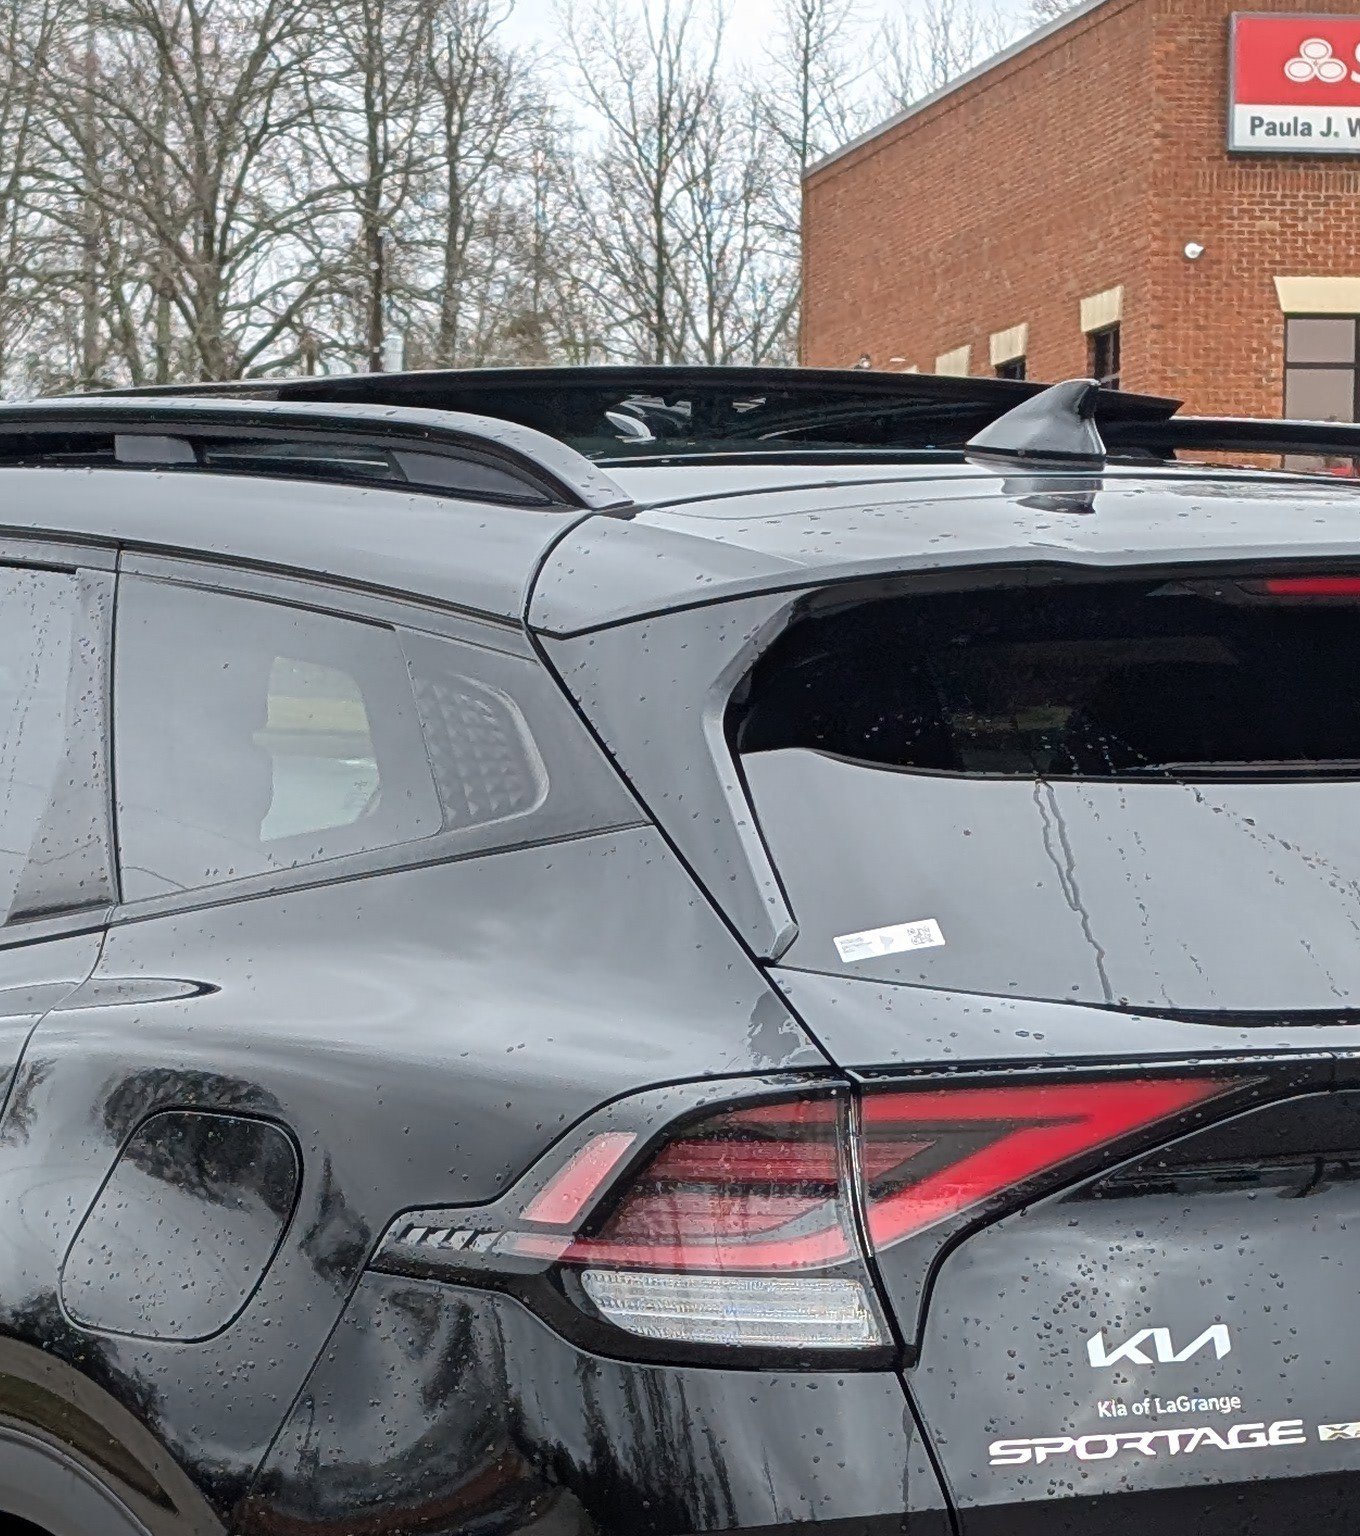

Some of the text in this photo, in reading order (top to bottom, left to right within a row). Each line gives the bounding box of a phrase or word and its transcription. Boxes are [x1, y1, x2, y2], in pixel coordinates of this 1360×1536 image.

[1249, 116, 1313, 138] Paula
[1319, 118, 1339, 139] J.
[1086, 1323, 1232, 1367] KIA
[1098, 1396, 1241, 1417] Kia of LaGrange
[989, 1419, 1306, 1465] SPORTAGE
